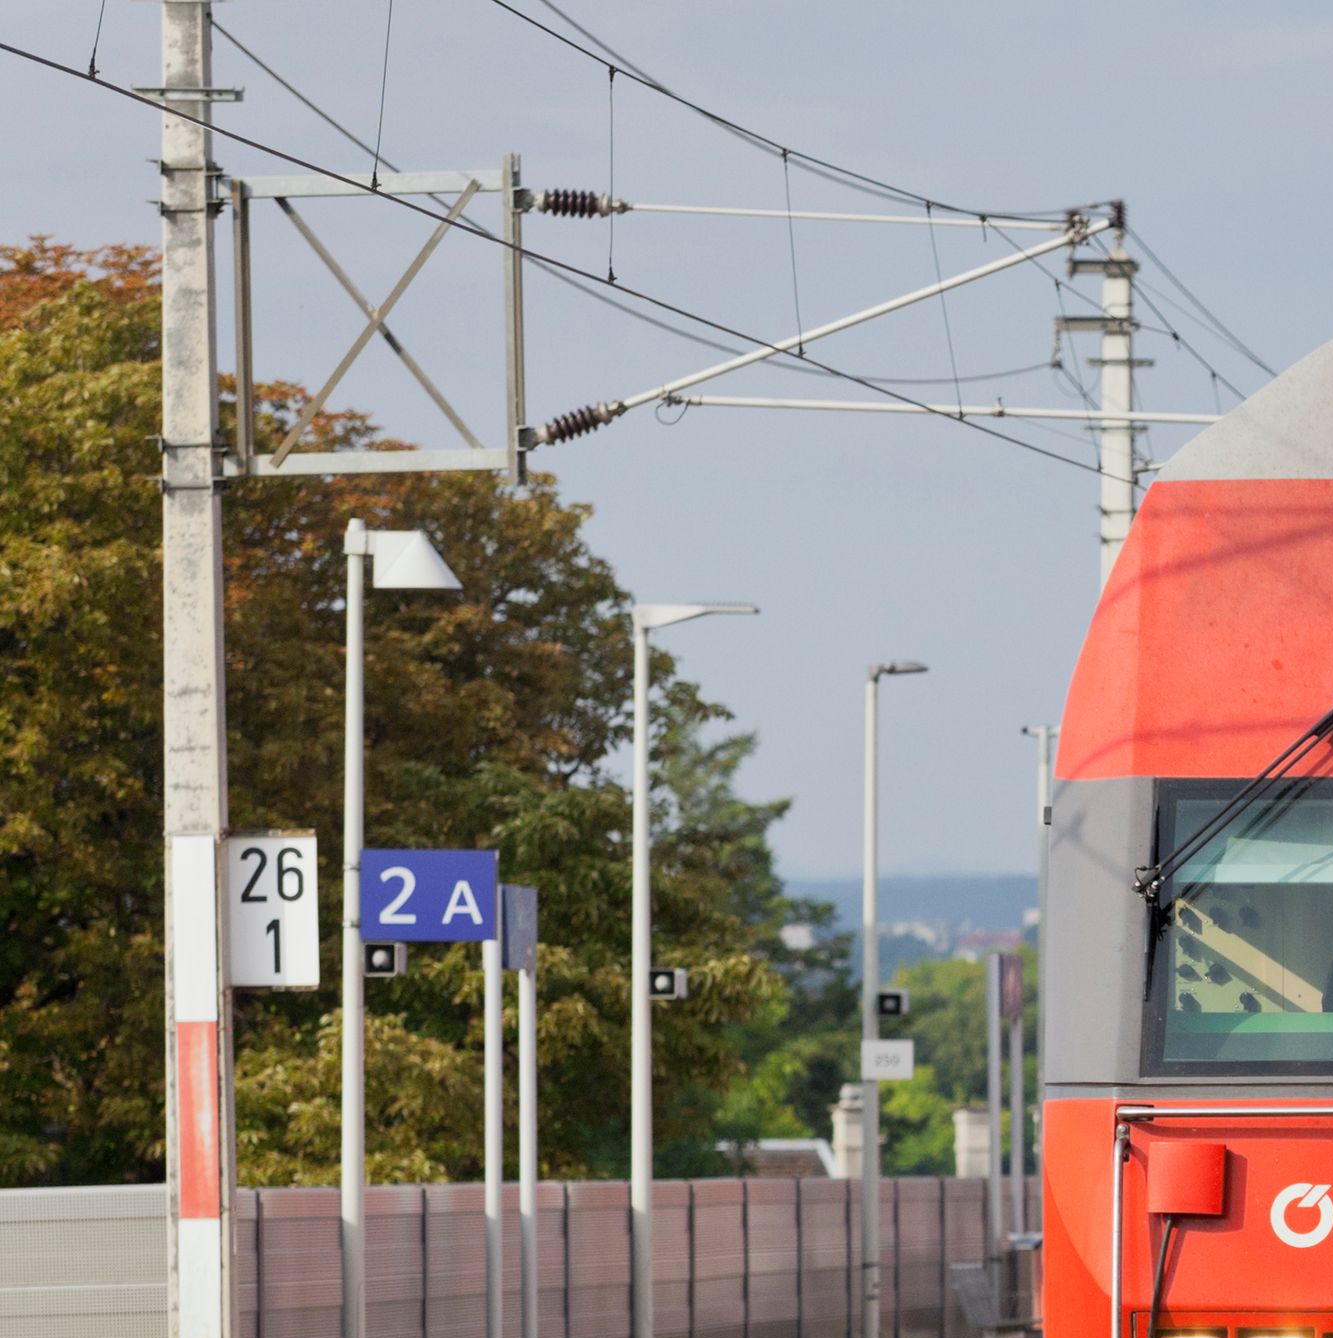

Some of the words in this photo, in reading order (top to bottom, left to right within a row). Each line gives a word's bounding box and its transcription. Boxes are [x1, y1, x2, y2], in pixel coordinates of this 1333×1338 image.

[239, 847, 304, 903] 26
[379, 866, 416, 925] 2
[442, 880, 484, 925] A
[265, 918, 281, 974] 1
